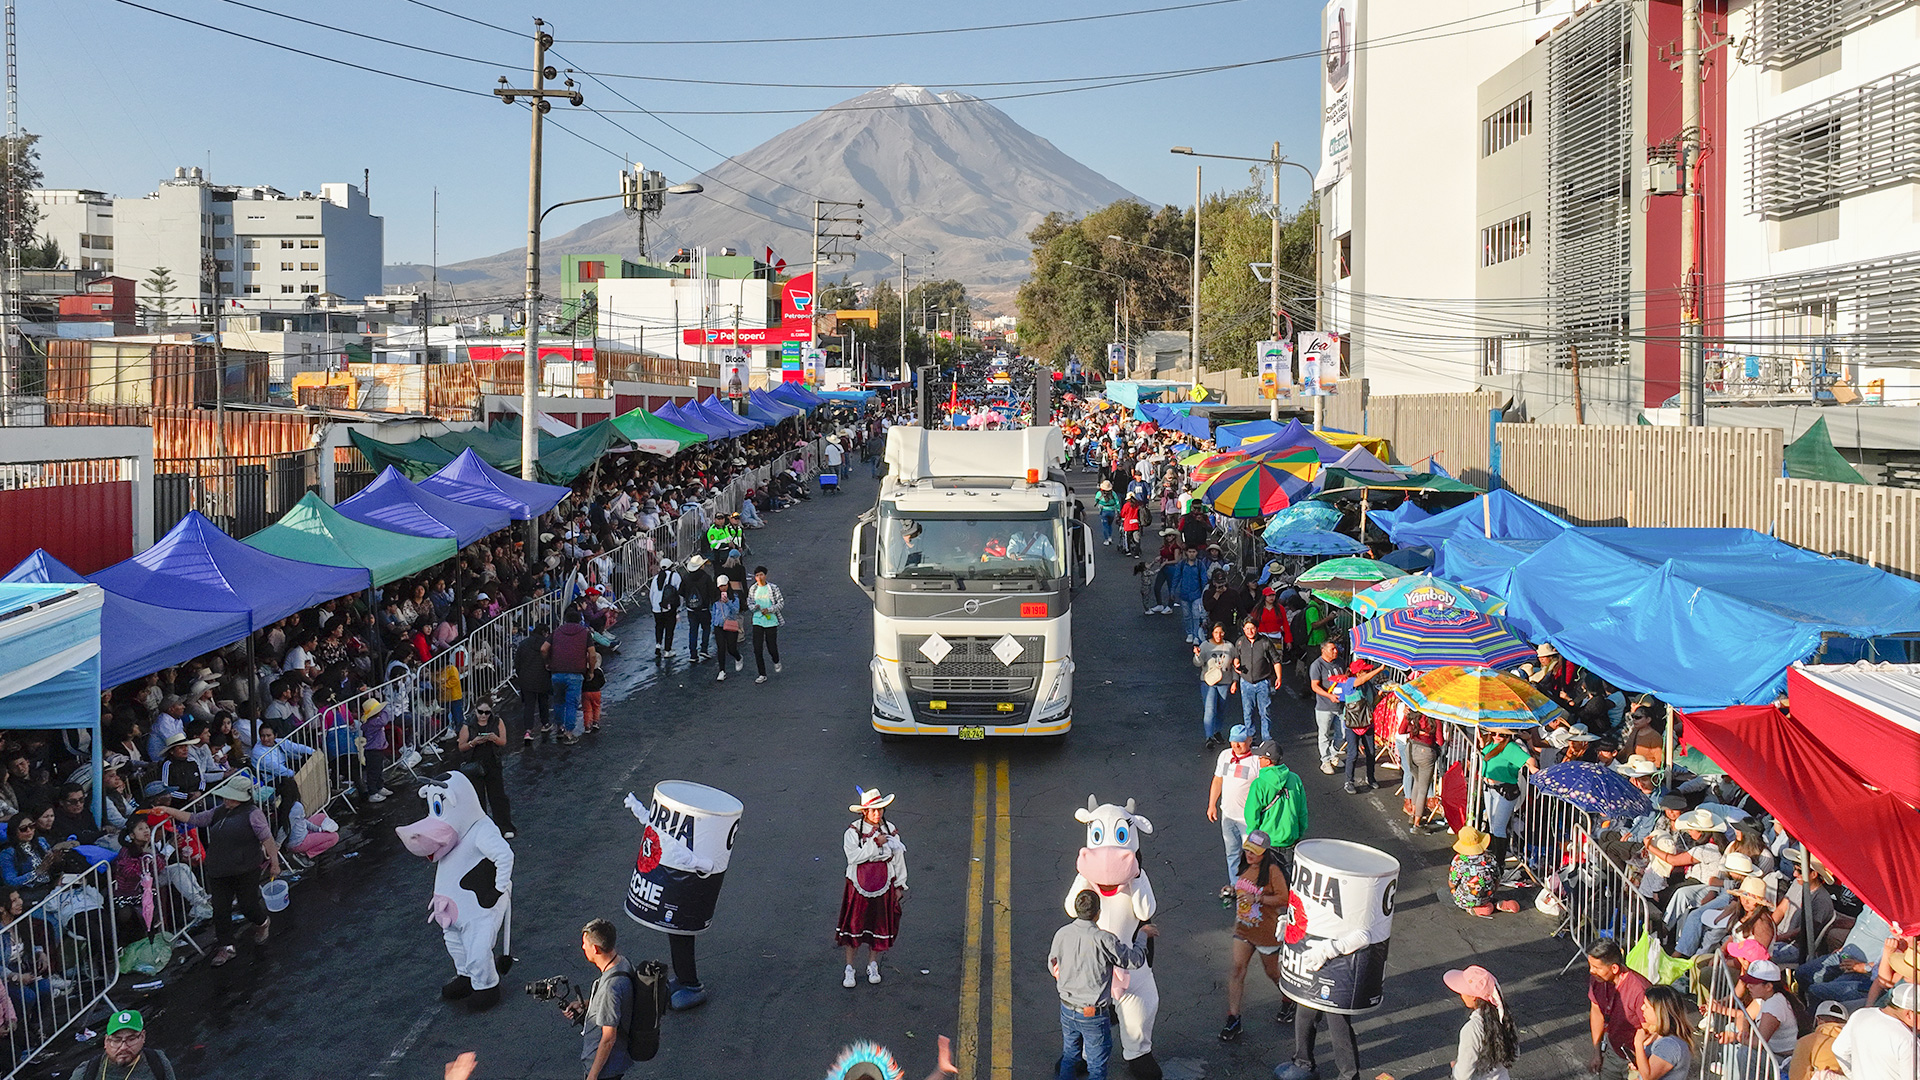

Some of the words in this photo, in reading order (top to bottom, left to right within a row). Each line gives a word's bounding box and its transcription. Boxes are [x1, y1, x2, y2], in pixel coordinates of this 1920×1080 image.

[720, 331, 765, 341] Petoperú
[1304, 338, 1330, 355] Loa
[725, 354, 746, 363] Black
[1023, 607, 1031, 615] UN
